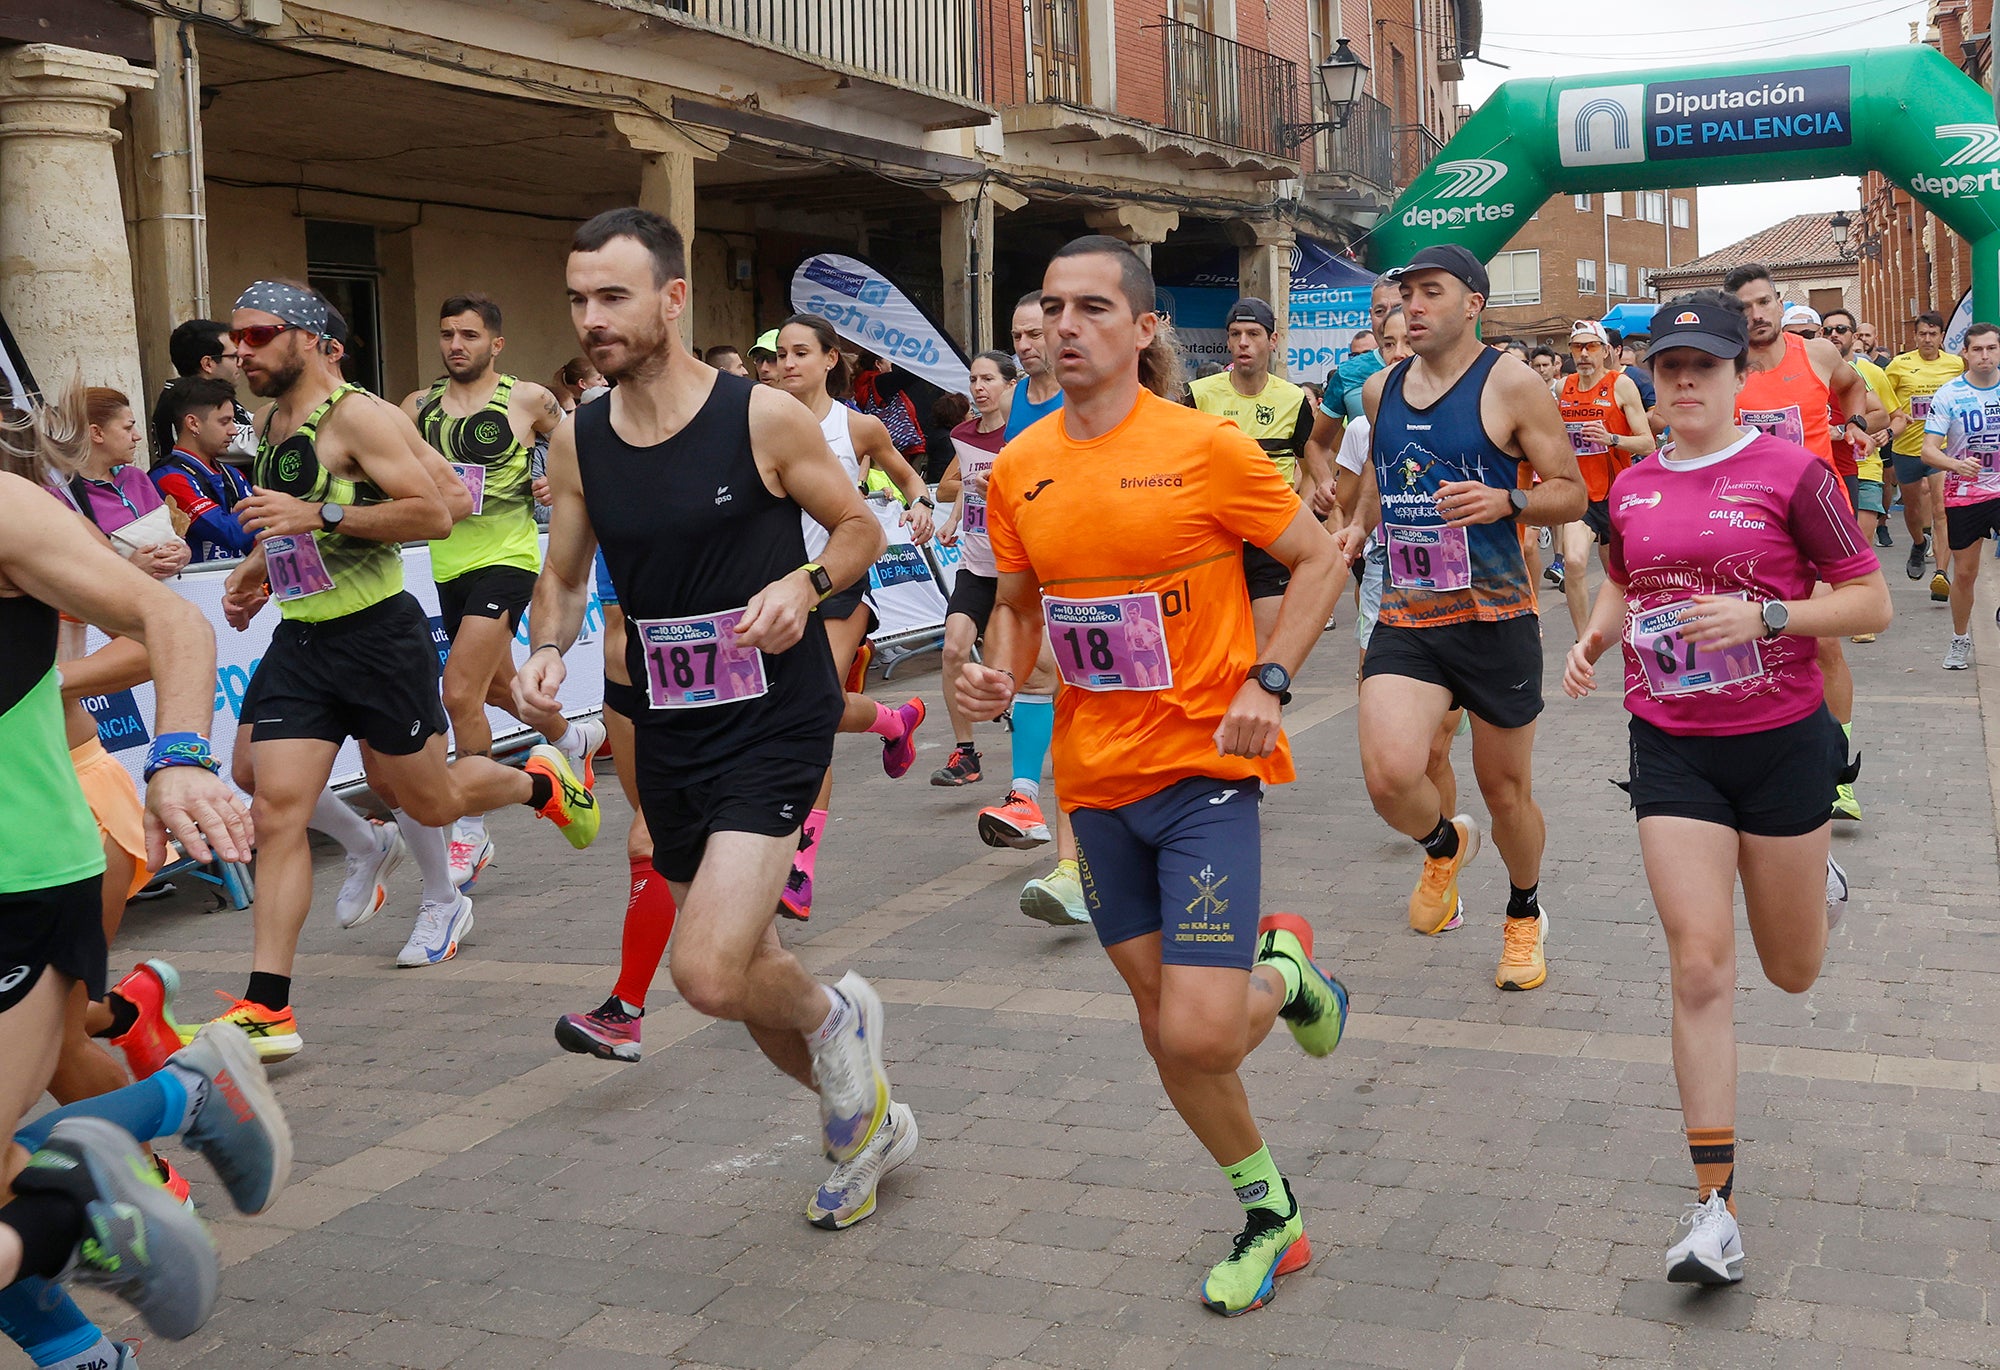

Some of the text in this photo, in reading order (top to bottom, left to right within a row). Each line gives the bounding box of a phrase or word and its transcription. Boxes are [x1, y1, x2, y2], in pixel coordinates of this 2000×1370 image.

[1655, 82, 1805, 117] Diputación
[1656, 111, 1844, 147] DE PALENCIA
[1402, 202, 1515, 230] deportes
[1561, 408, 1604, 418] REINOSA
[1960, 409, 1984, 434] 10
[1120, 476, 1183, 489] Briviesca
[1727, 482, 1774, 494] MERIDIANO
[1947, 472, 1961, 498] PALE
[968, 505, 984, 527] 51
[1708, 510, 1745, 520] GALEA
[1729, 518, 1766, 531] FLOOR
[1399, 545, 1431, 578] 19
[880, 566, 894, 579] DE
[1063, 605, 1098, 616] 10.000
[660, 624, 692, 635] 10.000
[1064, 627, 1114, 671] 18
[1652, 631, 1697, 675] 87
[650, 643, 718, 689] 187
[1088, 890, 1102, 910] LA
[1191, 922, 1208, 930] KM
[1209, 923, 1221, 932] 24
[1222, 922, 1231, 930] H
[1196, 931, 1235, 942] EDICIÓN
